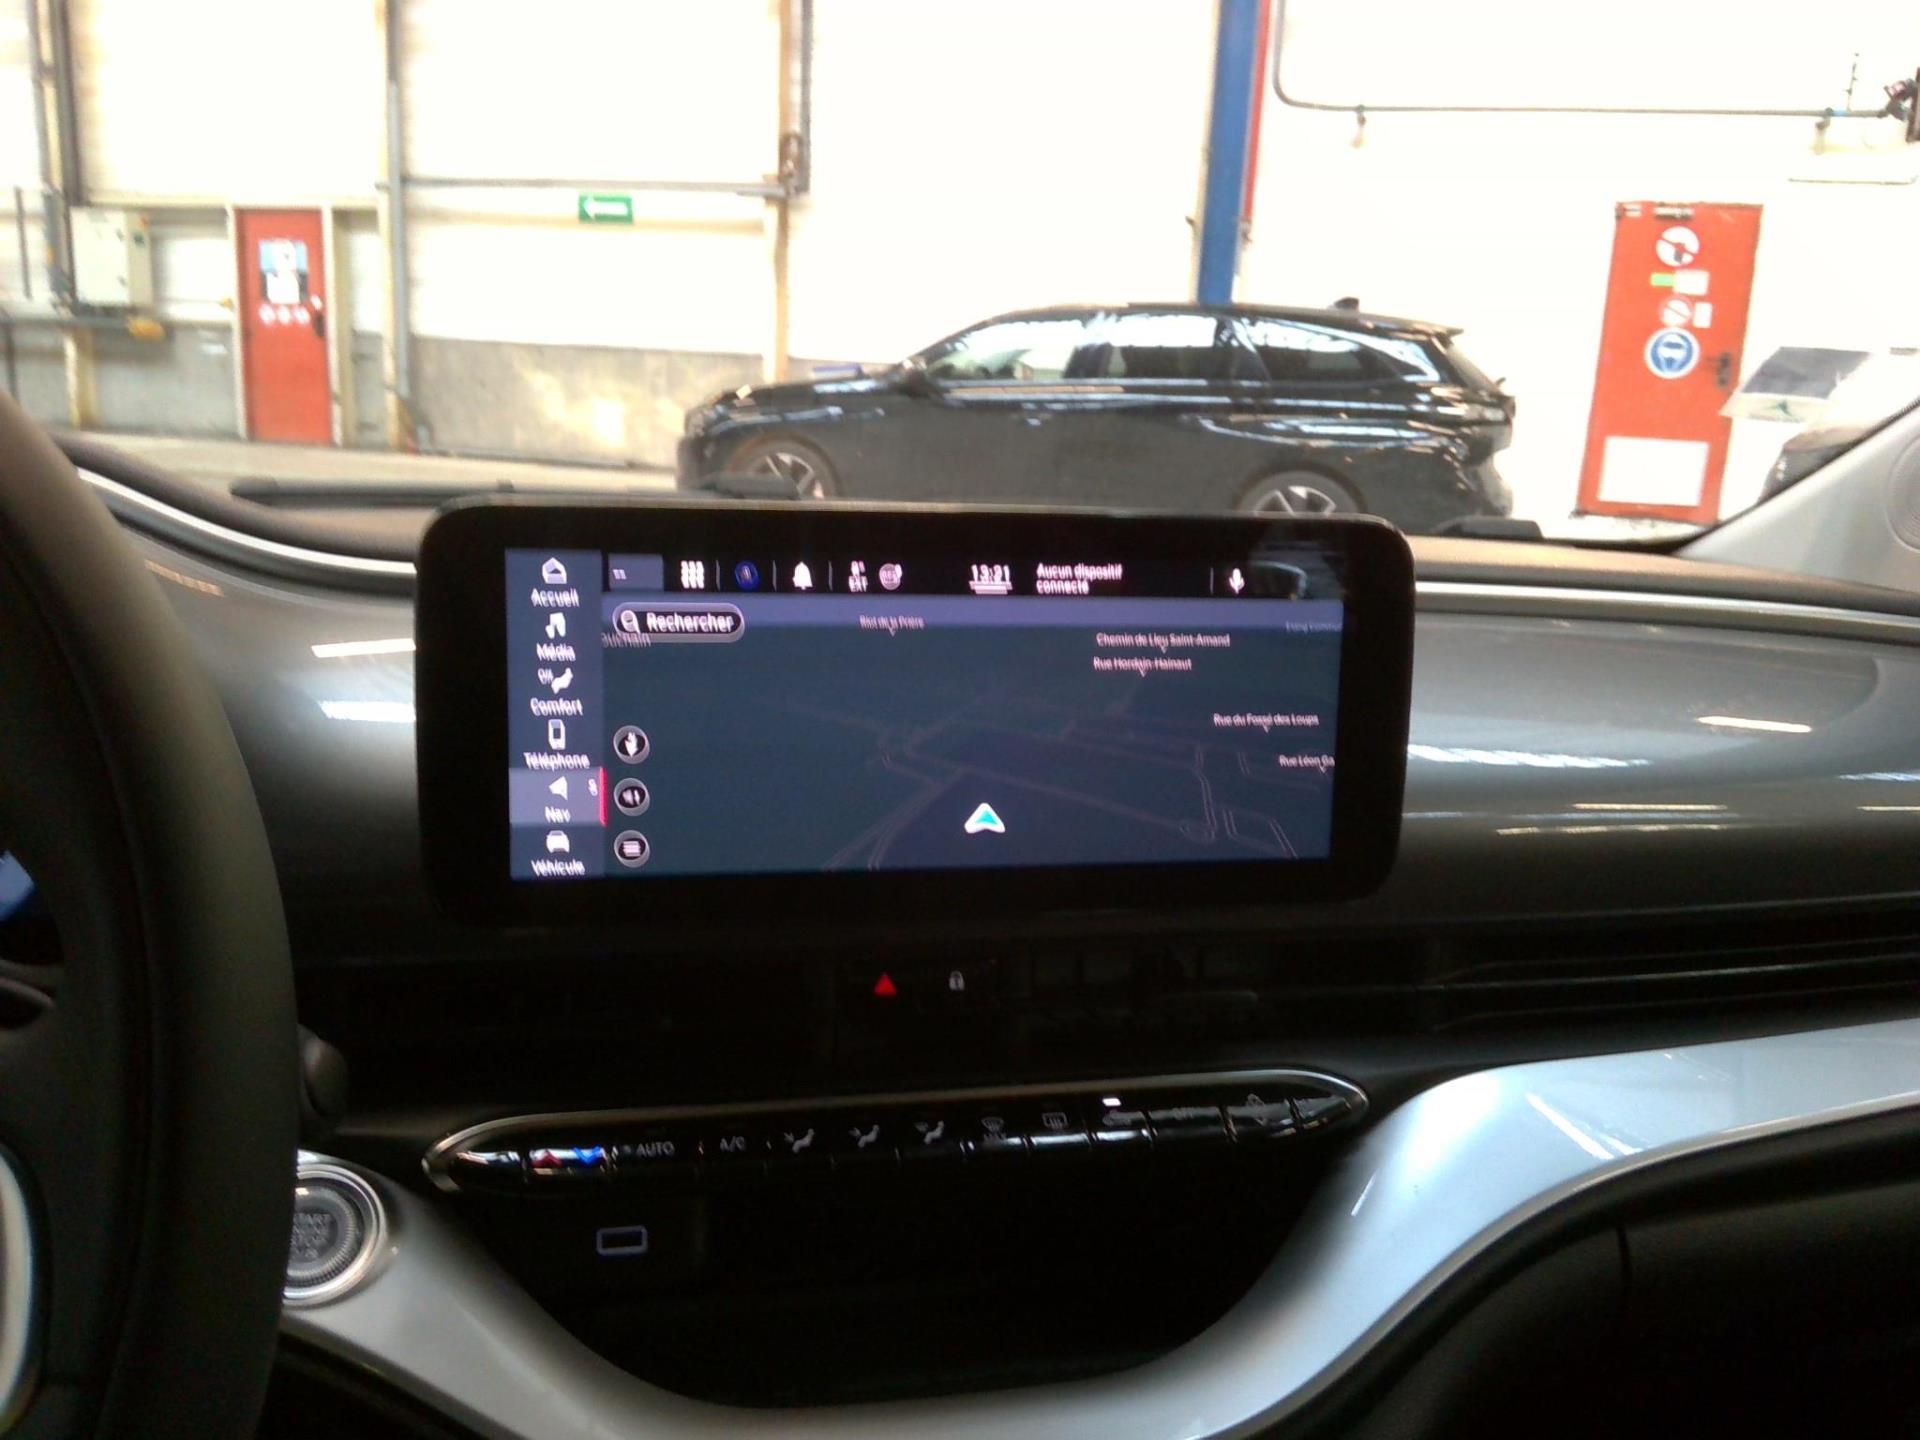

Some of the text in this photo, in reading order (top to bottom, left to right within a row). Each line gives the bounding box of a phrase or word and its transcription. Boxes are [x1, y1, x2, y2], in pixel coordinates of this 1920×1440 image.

[1036, 562, 1123, 582] Aucun dispositif
[1036, 577, 1090, 595] connecté
[531, 588, 580, 607] Accueil
[646, 612, 735, 632] Rechercher
[1096, 632, 1134, 648] Chemin
[1135, 632, 1148, 648] de
[536, 642, 577, 661] Média
[1093, 655, 1113, 671] Rue
[530, 697, 584, 716] Comfort
[1213, 712, 1233, 727] Rue
[1233, 713, 1247, 727] du
[1273, 713, 1291, 727] des
[1291, 712, 1320, 728] Loups
[523, 752, 591, 771] Téléphone
[1279, 754, 1298, 768] Rue
[545, 806, 571, 823] Nav
[531, 859, 586, 877] Véhicule
[636, 1141, 675, 1157] AUTO
[719, 1136, 745, 1152] A/C
